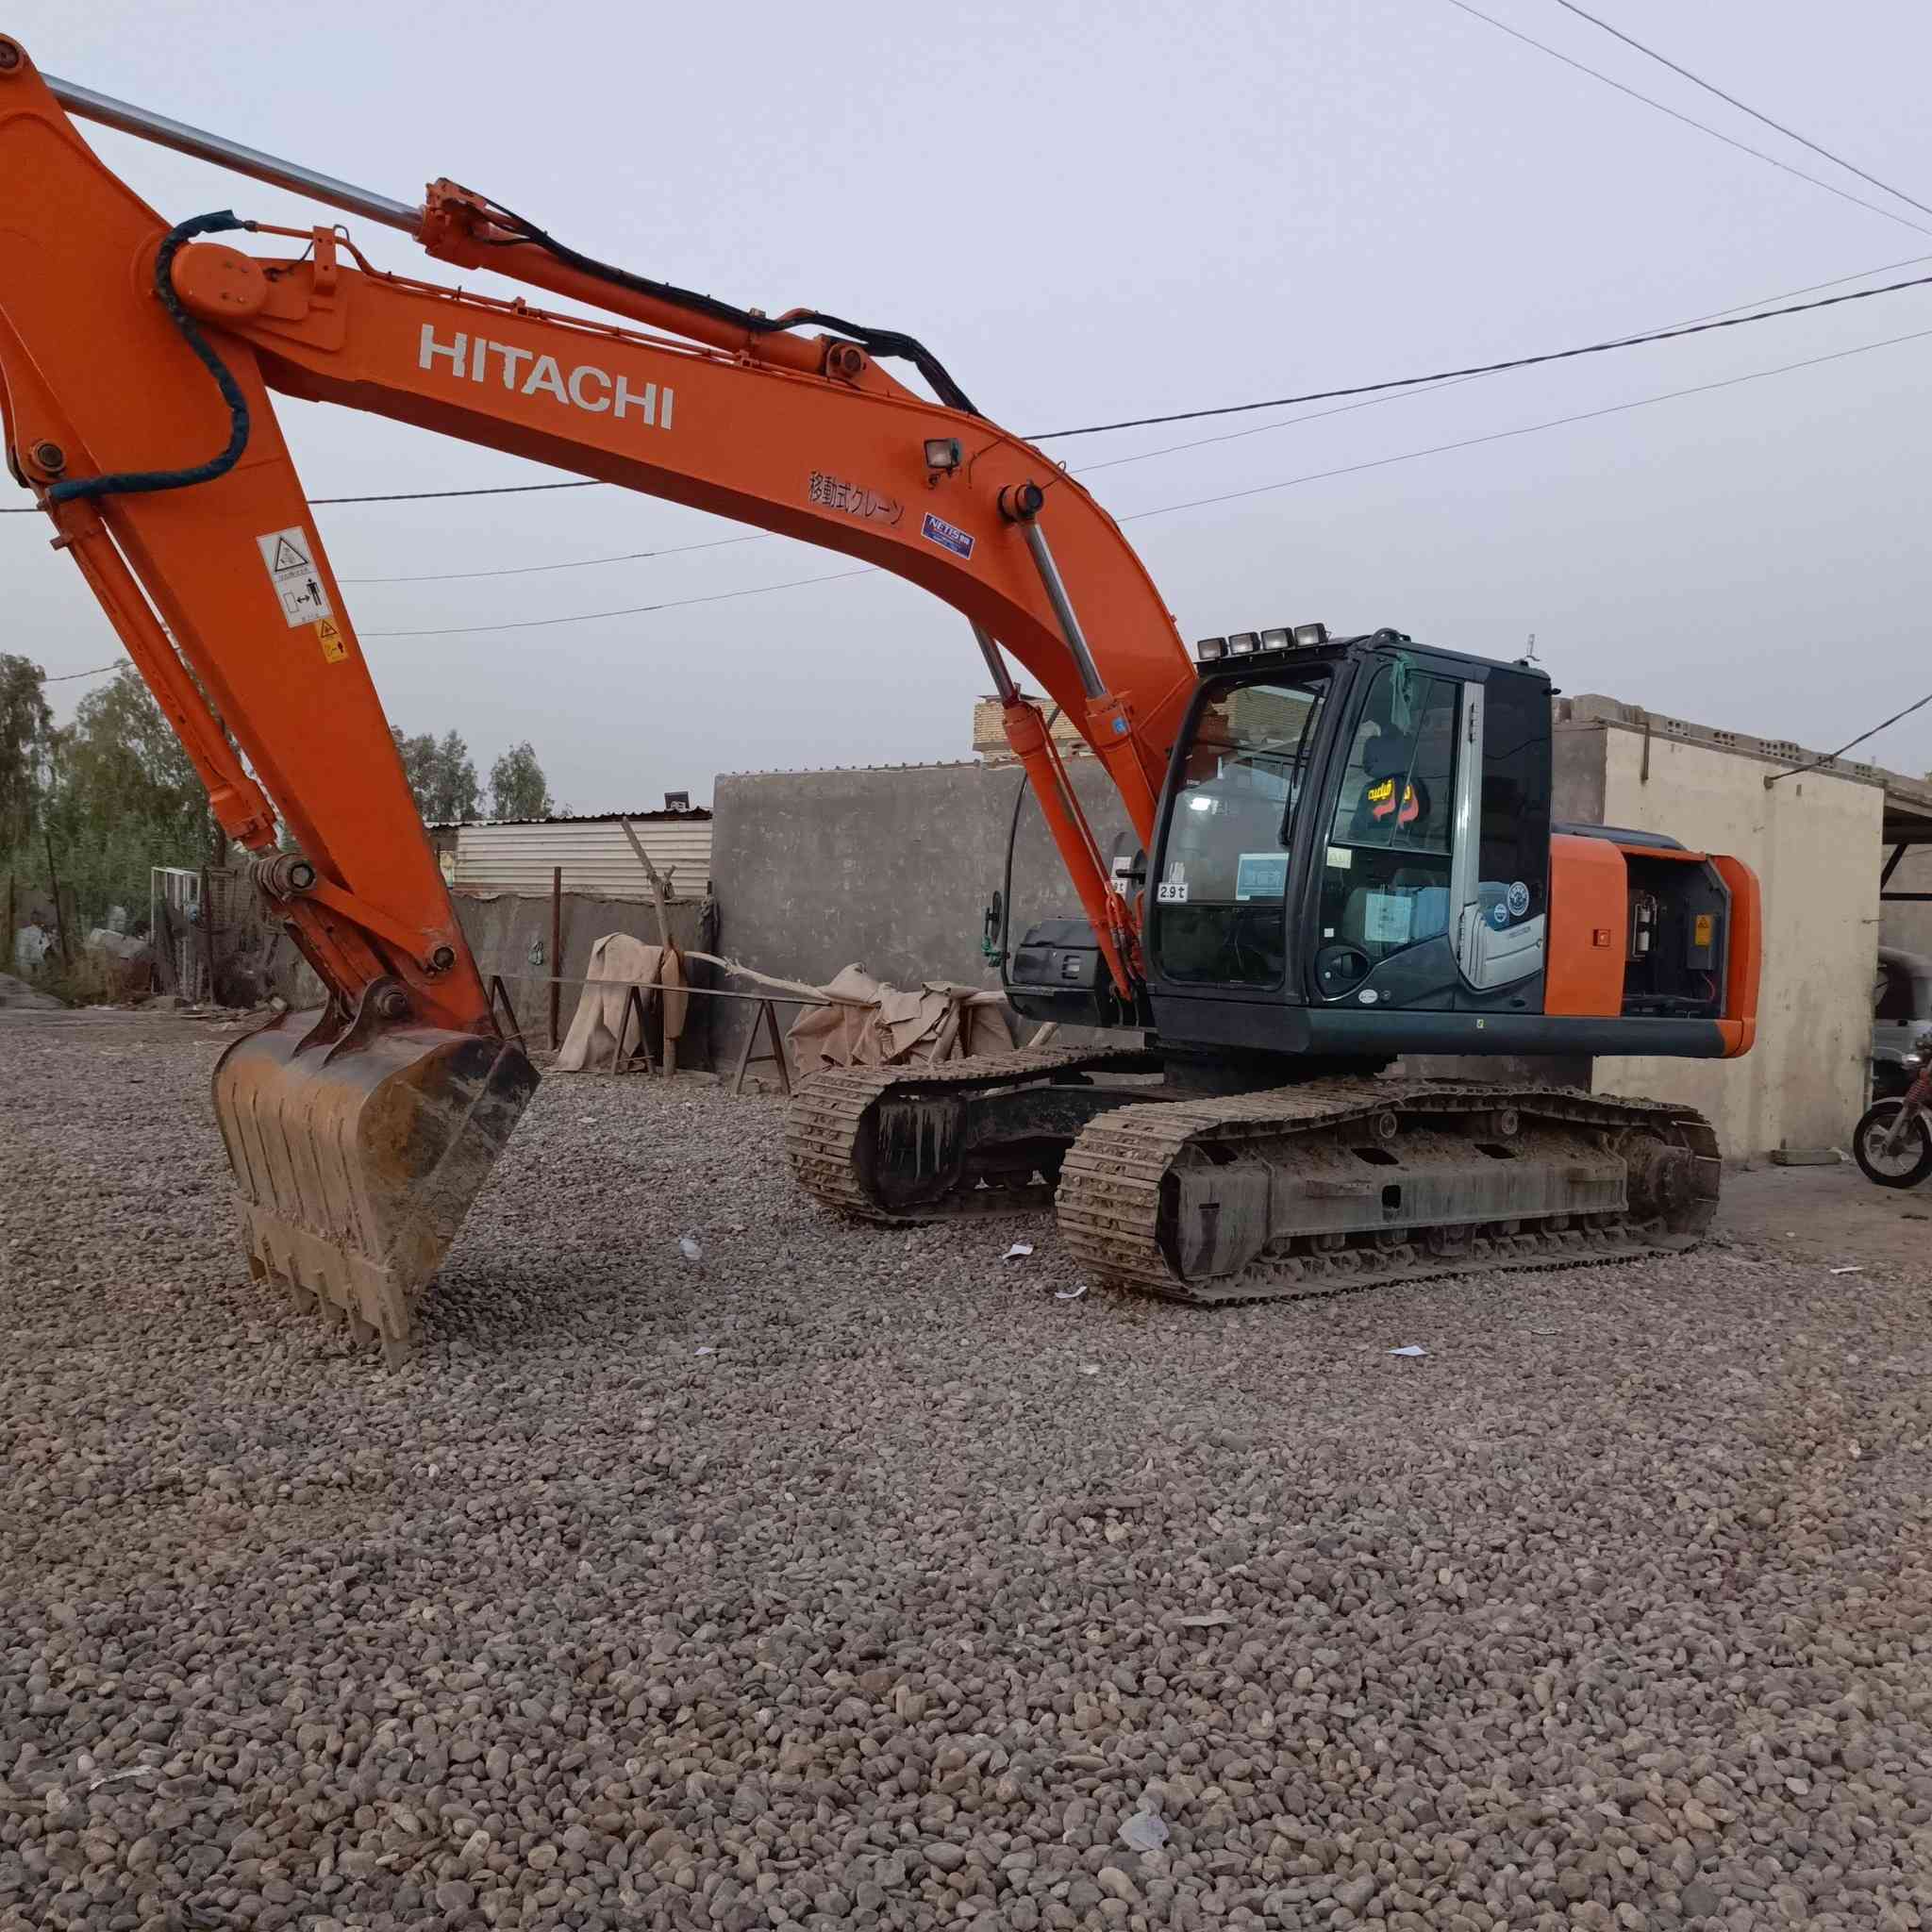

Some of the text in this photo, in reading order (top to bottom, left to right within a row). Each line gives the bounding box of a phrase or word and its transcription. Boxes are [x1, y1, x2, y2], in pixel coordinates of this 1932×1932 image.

[418, 323, 675, 430] HITACHI
[808, 470, 905, 525] 移動式クレーン
